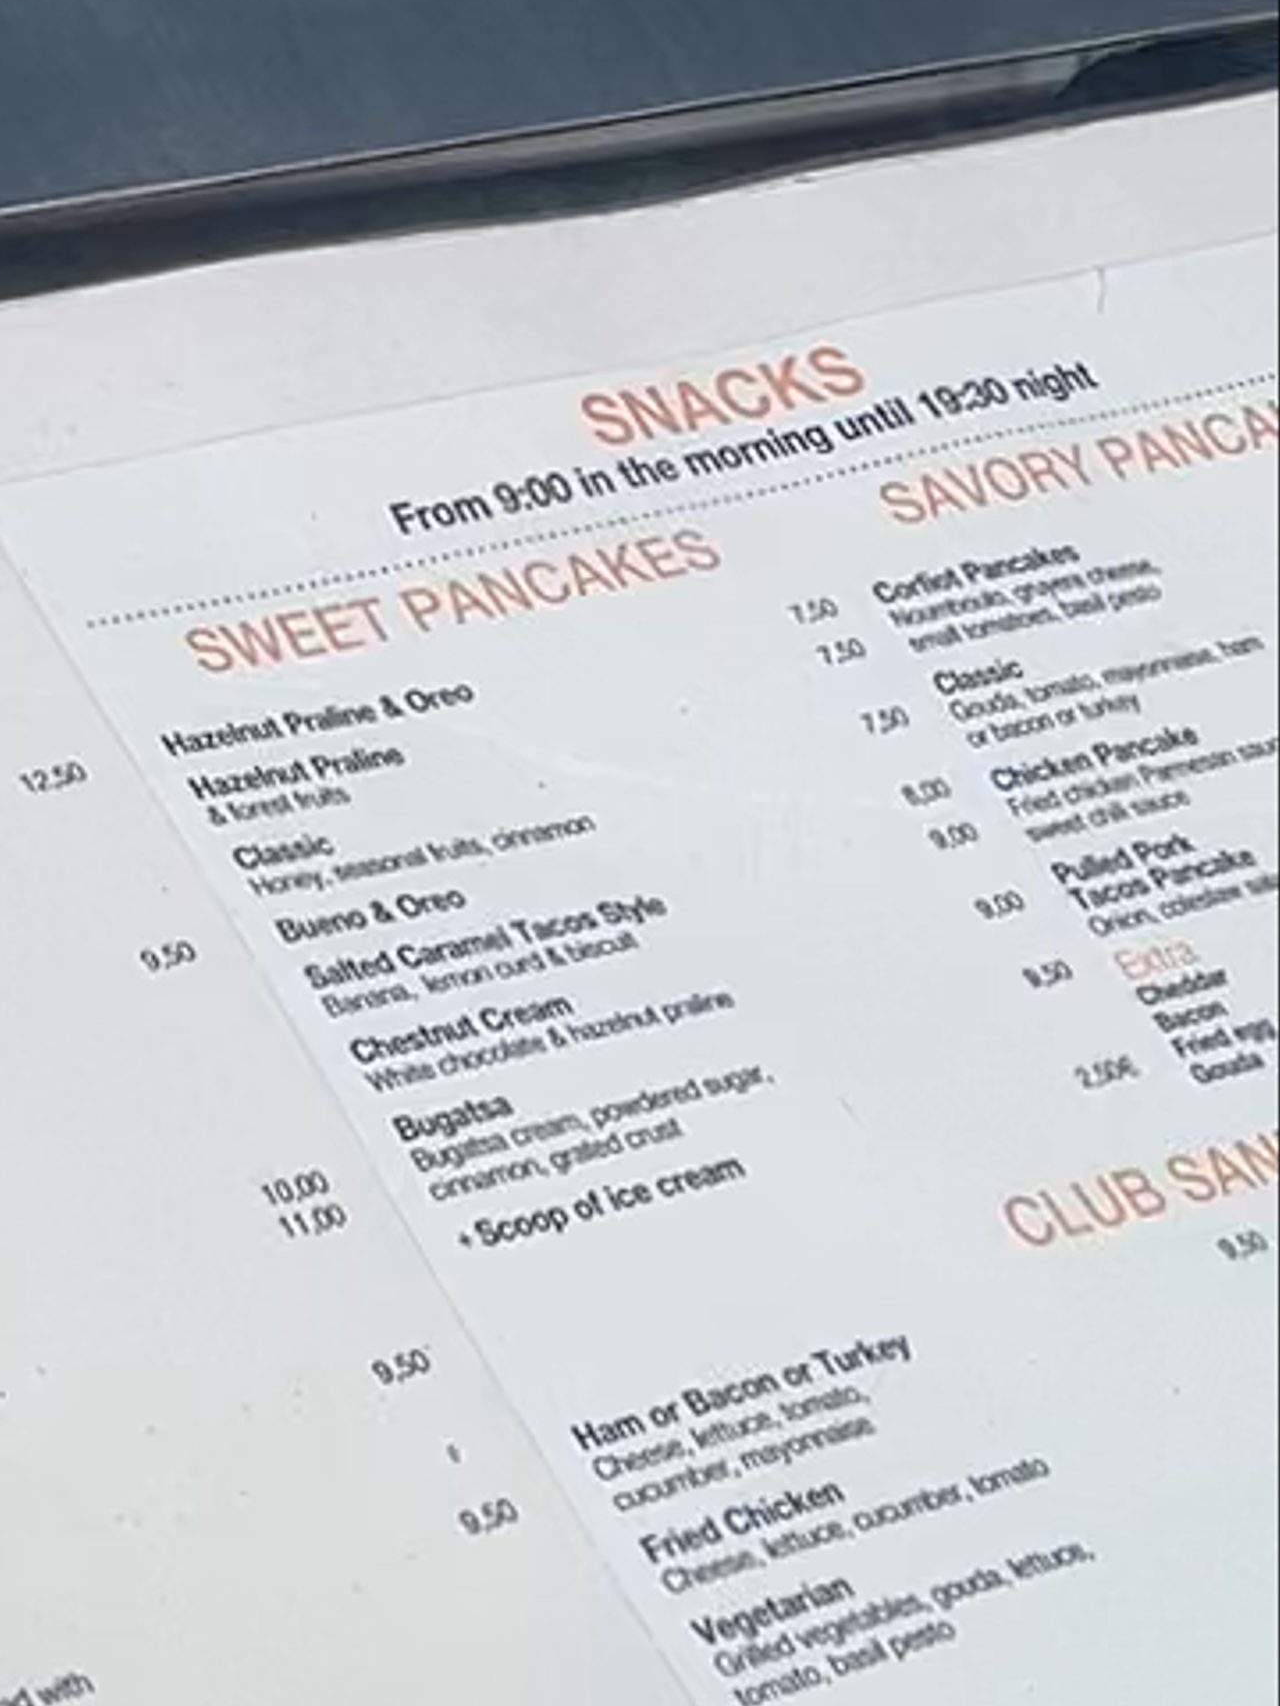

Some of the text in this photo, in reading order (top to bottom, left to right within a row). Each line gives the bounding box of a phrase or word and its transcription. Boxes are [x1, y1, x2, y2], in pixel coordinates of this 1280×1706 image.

[580, 345, 864, 446] SNACKS
[388, 359, 1100, 535] From 9:00 in the morning until 19:30 night
[878, 443, 1088, 525] SAVORY
[184, 528, 720, 673] SWEET PANCAKES
[160, 683, 474, 757] Hazelnut Praline & Oreo
[186, 747, 405, 800] Hazelnut Praline
[231, 833, 335, 871] Classic
[274, 889, 466, 944] Bueno & Oreo
[302, 895, 667, 990] Salted Caramel Tacos Style
[139, 940, 196, 971] 9,50
[348, 996, 574, 1065] Chestnut Cream
[260, 1169, 330, 1206] 10,00
[278, 1202, 347, 1237] 11,00
[473, 1158, 746, 1247] Scoop of ice cream
[1003, 1128, 1280, 1247] CLUB SAN
[370, 1348, 430, 1385] 9,50
[569, 1335, 911, 1451] Ham or Bacon or Turkey
[457, 1497, 518, 1535] 9,50
[638, 1482, 845, 1564] Fried Chicken
[689, 1577, 855, 1645] Vegetarian
